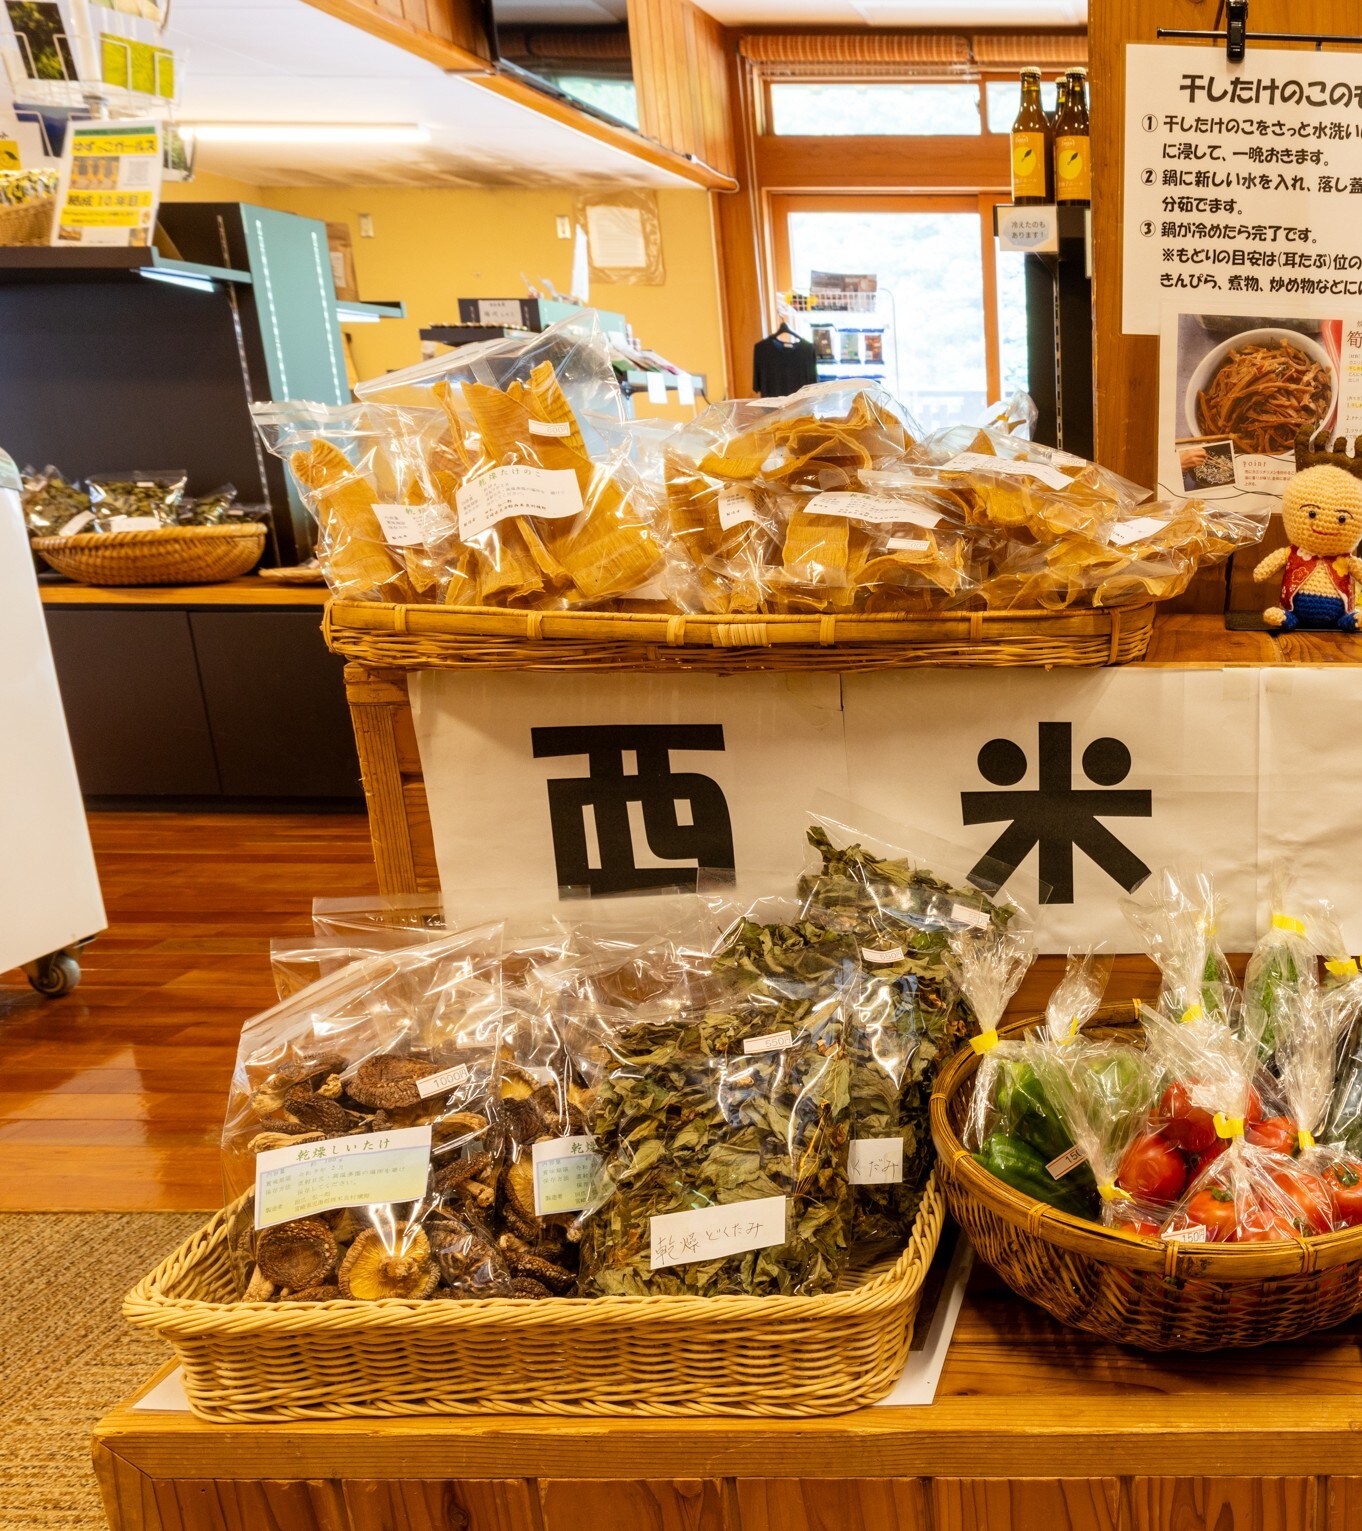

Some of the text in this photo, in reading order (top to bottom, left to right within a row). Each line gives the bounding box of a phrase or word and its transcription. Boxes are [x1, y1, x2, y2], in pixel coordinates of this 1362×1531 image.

[1162, 143, 1330, 167] に浸して、一晩おきます。
[1162, 196, 1244, 216] 分茹でます。
[1011, 221, 1046, 229] 冷えたのも
[1161, 221, 1318, 244] 鍋が冷めたら完了です。
[765, 1036, 791, 1048] 550円
[433, 1068, 468, 1089] 1000円
[296, 1138, 391, 1162] 乾燥しいたけ
